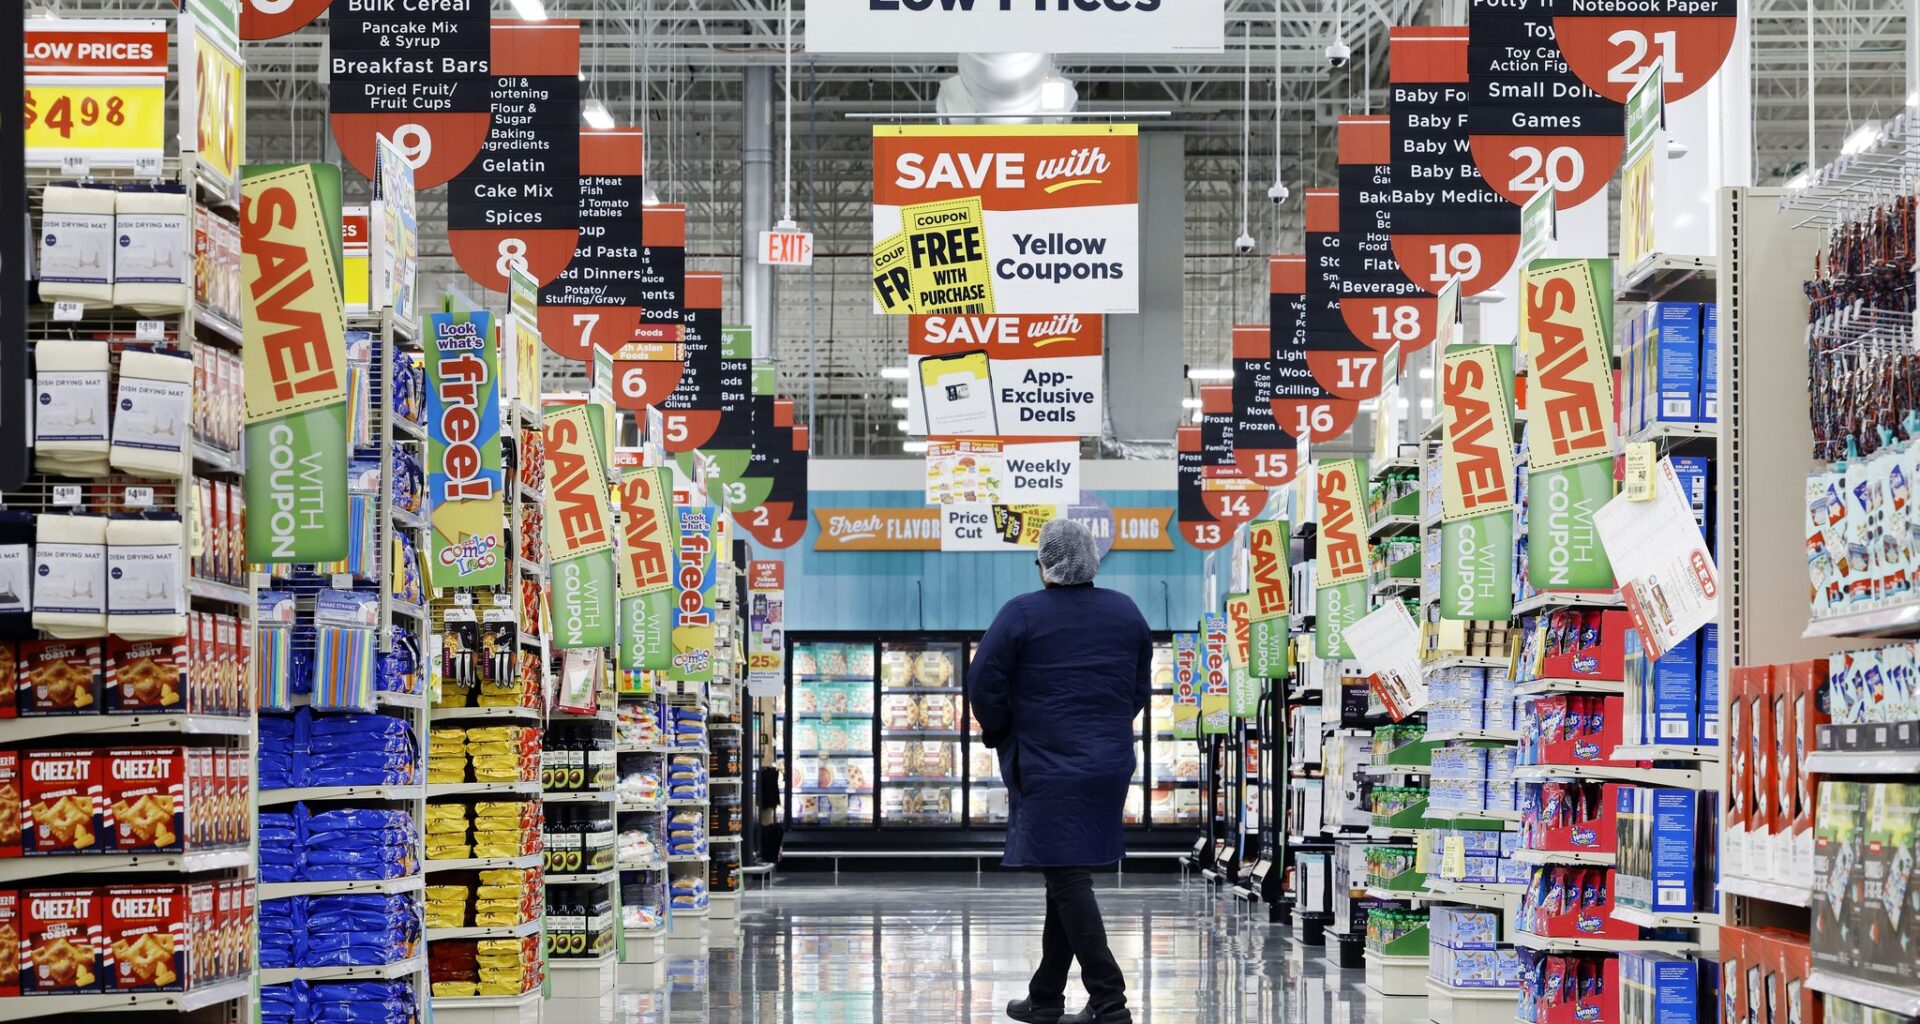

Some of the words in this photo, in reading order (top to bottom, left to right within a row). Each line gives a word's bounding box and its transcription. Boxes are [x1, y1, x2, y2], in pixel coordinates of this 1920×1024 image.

[1573, 0, 1660, 12] Notebook
[1667, 0, 1718, 14] Paper
[362, 22, 427, 34] Pancake
[432, 22, 458, 34] Mix
[380, 36, 390, 47] &
[396, 35, 441, 49] Syrup
[78, 43, 153, 60] PRICES
[1505, 47, 1530, 60] Toy
[1607, 30, 1683, 83] 21
[333, 57, 434, 74] Breakfast
[442, 58, 488, 73] Bars
[1490, 60, 1539, 72] Action
[365, 83, 407, 96] Dried
[412, 82, 458, 97] Fruit/
[498, 78, 516, 88] Oil
[521, 78, 529, 88] &
[1489, 82, 1544, 98] Small
[370, 98, 407, 109] Fruit
[413, 98, 452, 110] Cups
[1395, 89, 1438, 105] Baby
[491, 104, 523, 113] Flour
[528, 104, 537, 113] &
[495, 115, 533, 126] Sugar
[1408, 114, 1451, 129] Baby
[1512, 112, 1581, 128] Games
[491, 129, 535, 140] Baking
[392, 123, 432, 169] 9
[1404, 139, 1447, 155] Baby
[482, 159, 546, 172] Gelatin
[895, 153, 1025, 190] SAVE
[1036, 147, 1110, 180] with
[1411, 164, 1454, 180] Baby
[1508, 146, 1584, 191] 20
[595, 177, 622, 186] Meat
[474, 184, 518, 197] Cake
[524, 184, 553, 197] Mix
[580, 186, 603, 195] Fish
[1392, 190, 1437, 206] Baby
[1442, 190, 1508, 204] Medici
[588, 199, 629, 208] Tomato
[485, 210, 543, 224] Spices
[917, 211, 968, 227] COUPON
[597, 247, 637, 258] Pasta
[768, 234, 805, 262] EXIT
[909, 226, 982, 269] FREE
[1012, 233, 1106, 255] Yellow
[1359, 242, 1387, 251] Food
[496, 238, 528, 278] 8
[1429, 243, 1482, 282] 19
[584, 268, 641, 279] Dinners
[933, 268, 967, 286] WITH
[996, 258, 1123, 284] Coupons
[240, 186, 338, 402] SAVE!
[565, 285, 607, 296] Potato/
[920, 283, 986, 307] PURCHASE
[545, 294, 626, 306] Stuffing/Gravy
[439, 322, 476, 336] Look
[573, 314, 600, 347] 7
[924, 316, 1020, 344] SAVE
[1027, 314, 1083, 337] with
[1372, 306, 1421, 340] 18
[635, 329, 663, 337] Foods
[437, 336, 483, 350] what's
[721, 362, 747, 371] Diets
[1246, 362, 1261, 370] Ice
[1337, 358, 1377, 388] 17
[1528, 278, 1607, 456] SAVE!
[622, 368, 647, 398] 6
[1023, 369, 1074, 387] App-
[722, 392, 745, 401] Bars
[1001, 388, 1095, 404] Exclusive
[1275, 385, 1320, 396] Grilling
[1019, 407, 1076, 422] Deals
[1296, 405, 1334, 432] 16
[438, 353, 492, 500] free!
[666, 416, 688, 442] 5
[1240, 422, 1275, 431] Frozen
[1444, 360, 1508, 508] SAVE!
[1006, 459, 1071, 475] Weekly
[1255, 454, 1288, 477] 15
[269, 425, 295, 557] COUPON
[299, 452, 324, 529] WITH
[544, 418, 606, 550] SAVE!
[1014, 476, 1064, 489] Deals
[731, 482, 746, 503] 3
[1221, 496, 1250, 516] 14
[682, 513, 706, 522] Look
[753, 506, 768, 526] 2
[949, 511, 988, 524] Price
[1318, 470, 1364, 578] SAVE!
[620, 478, 668, 588] SAVE!
[680, 522, 710, 531] what's
[772, 528, 783, 542] 1
[829, 515, 883, 536] Fresh
[887, 518, 941, 539] FLAVOR
[955, 526, 983, 539] Cut
[1121, 518, 1159, 539] LONG
[1195, 525, 1221, 544] 13
[1549, 475, 1569, 584] COUPON
[1573, 498, 1593, 562] WITH
[1251, 528, 1286, 614] SAVE!
[1457, 524, 1475, 616] COUPON
[1478, 544, 1495, 598] WITH
[679, 532, 711, 627] free!
[564, 564, 582, 645] COUPON
[584, 580, 600, 627] WITH
[1328, 590, 1341, 657] COUPON
[632, 600, 645, 667] COUPON
[648, 614, 660, 654] WITH
[1258, 622, 1268, 677] COUPON
[1270, 634, 1280, 666] WITH
[750, 655, 769, 668] 25
[1208, 632, 1228, 694] free!
[1178, 650, 1196, 704] free!
[121, 786, 158, 798] ORIGINAL
[41, 927, 78, 940] TOASTY
[121, 925, 158, 937] ORIGINAL
